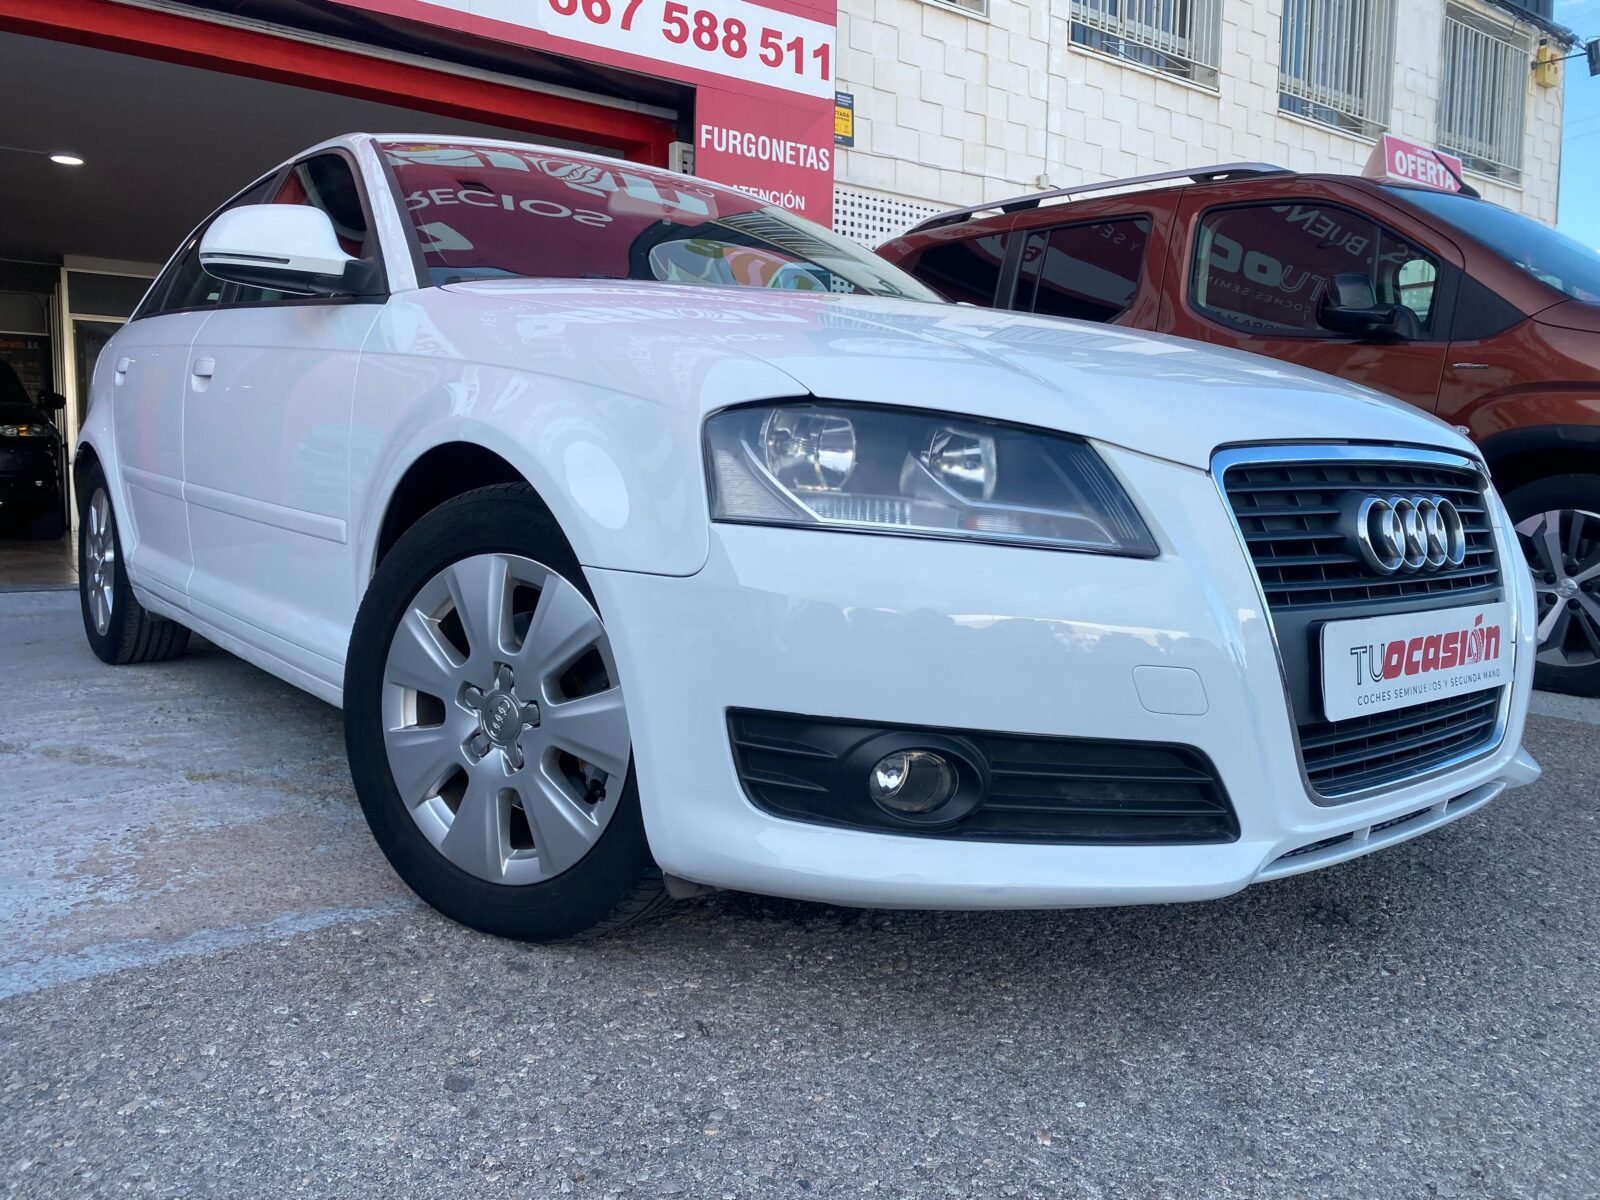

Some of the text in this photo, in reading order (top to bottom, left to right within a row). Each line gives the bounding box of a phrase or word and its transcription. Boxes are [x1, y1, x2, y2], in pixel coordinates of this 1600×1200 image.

[662, 1, 747, 59] 588
[759, 27, 830, 81] 511
[701, 124, 830, 171] FURGONETAS
[1395, 150, 1456, 191] OFERTA
[1357, 690, 1391, 706] COCHES
[1443, 679, 1449, 690] Y
[1450, 672, 1482, 688] SEGUNDA
[1483, 667, 1501, 680] MANO
